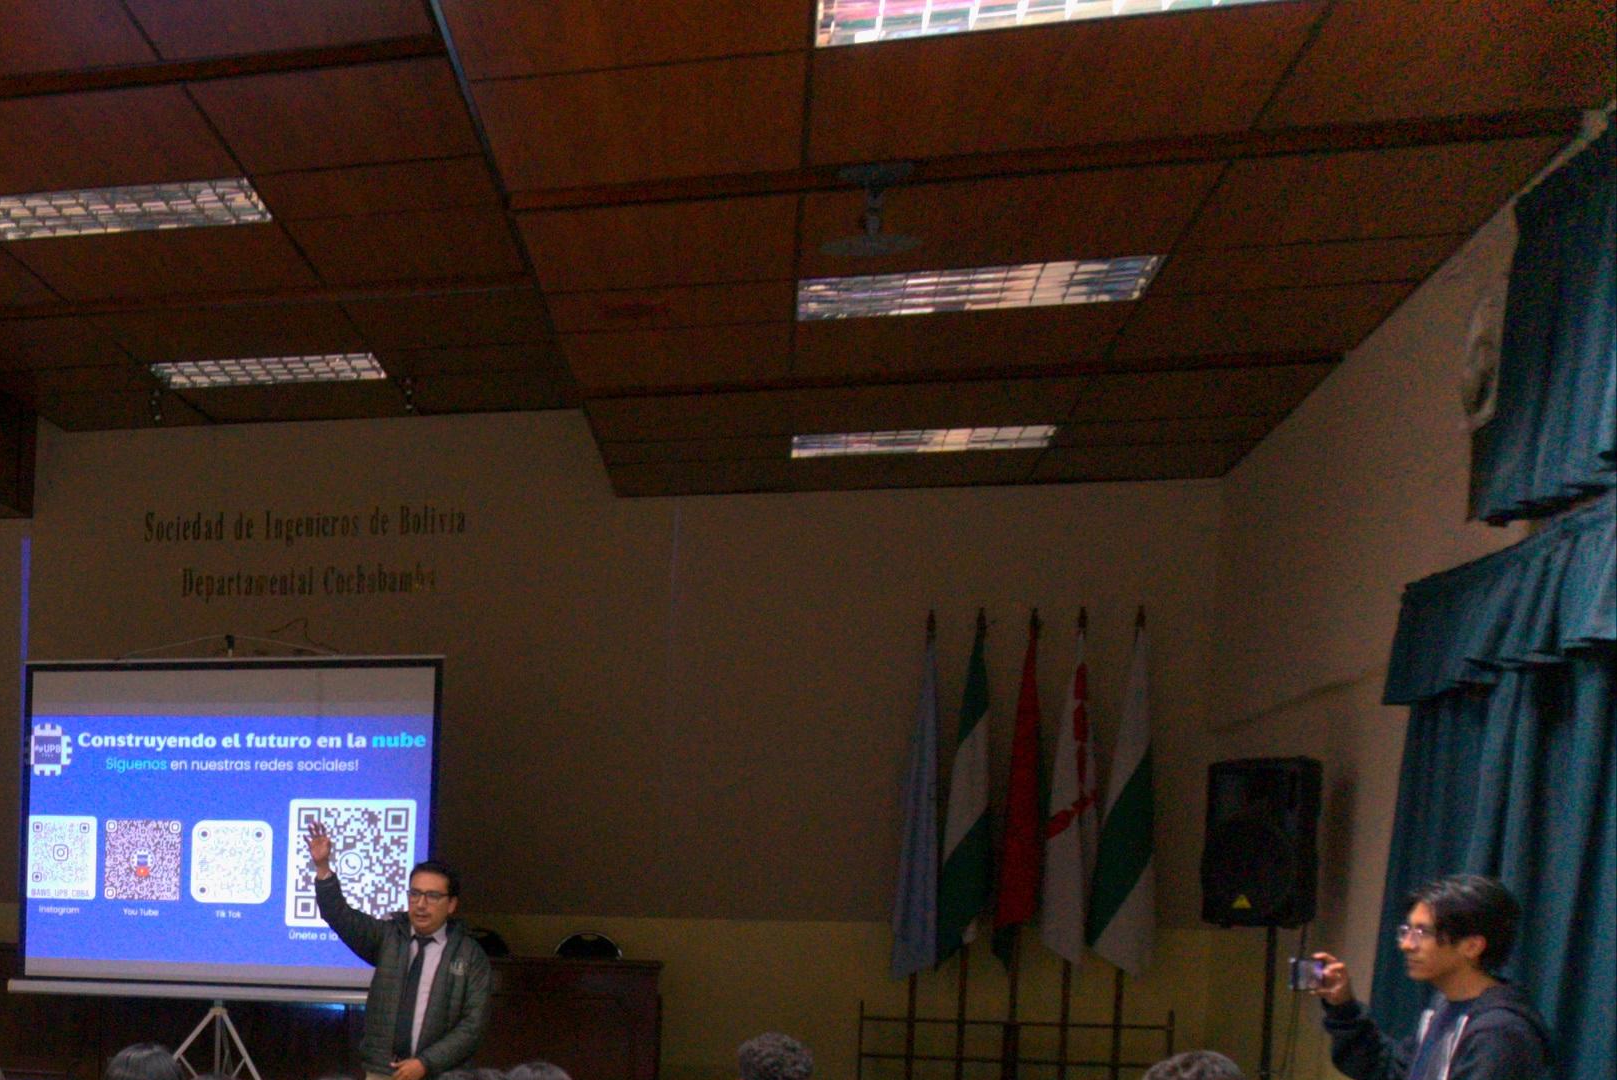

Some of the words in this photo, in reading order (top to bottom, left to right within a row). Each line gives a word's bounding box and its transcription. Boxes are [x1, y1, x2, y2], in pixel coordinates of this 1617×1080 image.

[144, 511, 225, 543] Sociedad
[234, 512, 254, 540] de
[265, 510, 360, 546] Ingenieros
[369, 506, 389, 536] de
[400, 505, 466, 536] Bolivia
[182, 566, 314, 603] Departamental
[78, 732, 217, 752] Construyendo
[221, 733, 241, 748] el
[245, 733, 312, 749] futuro
[316, 735, 342, 749] en
[346, 732, 367, 749] la
[372, 732, 426, 748] nube
[170, 759, 188, 771] en
[191, 759, 251, 772] nuestras
[254, 758, 294, 771] redes
[297, 757, 359, 772] sociales!
[38, 904, 80, 915] Instagram
[123, 908, 139, 916] You
[140, 908, 159, 917] Tube
